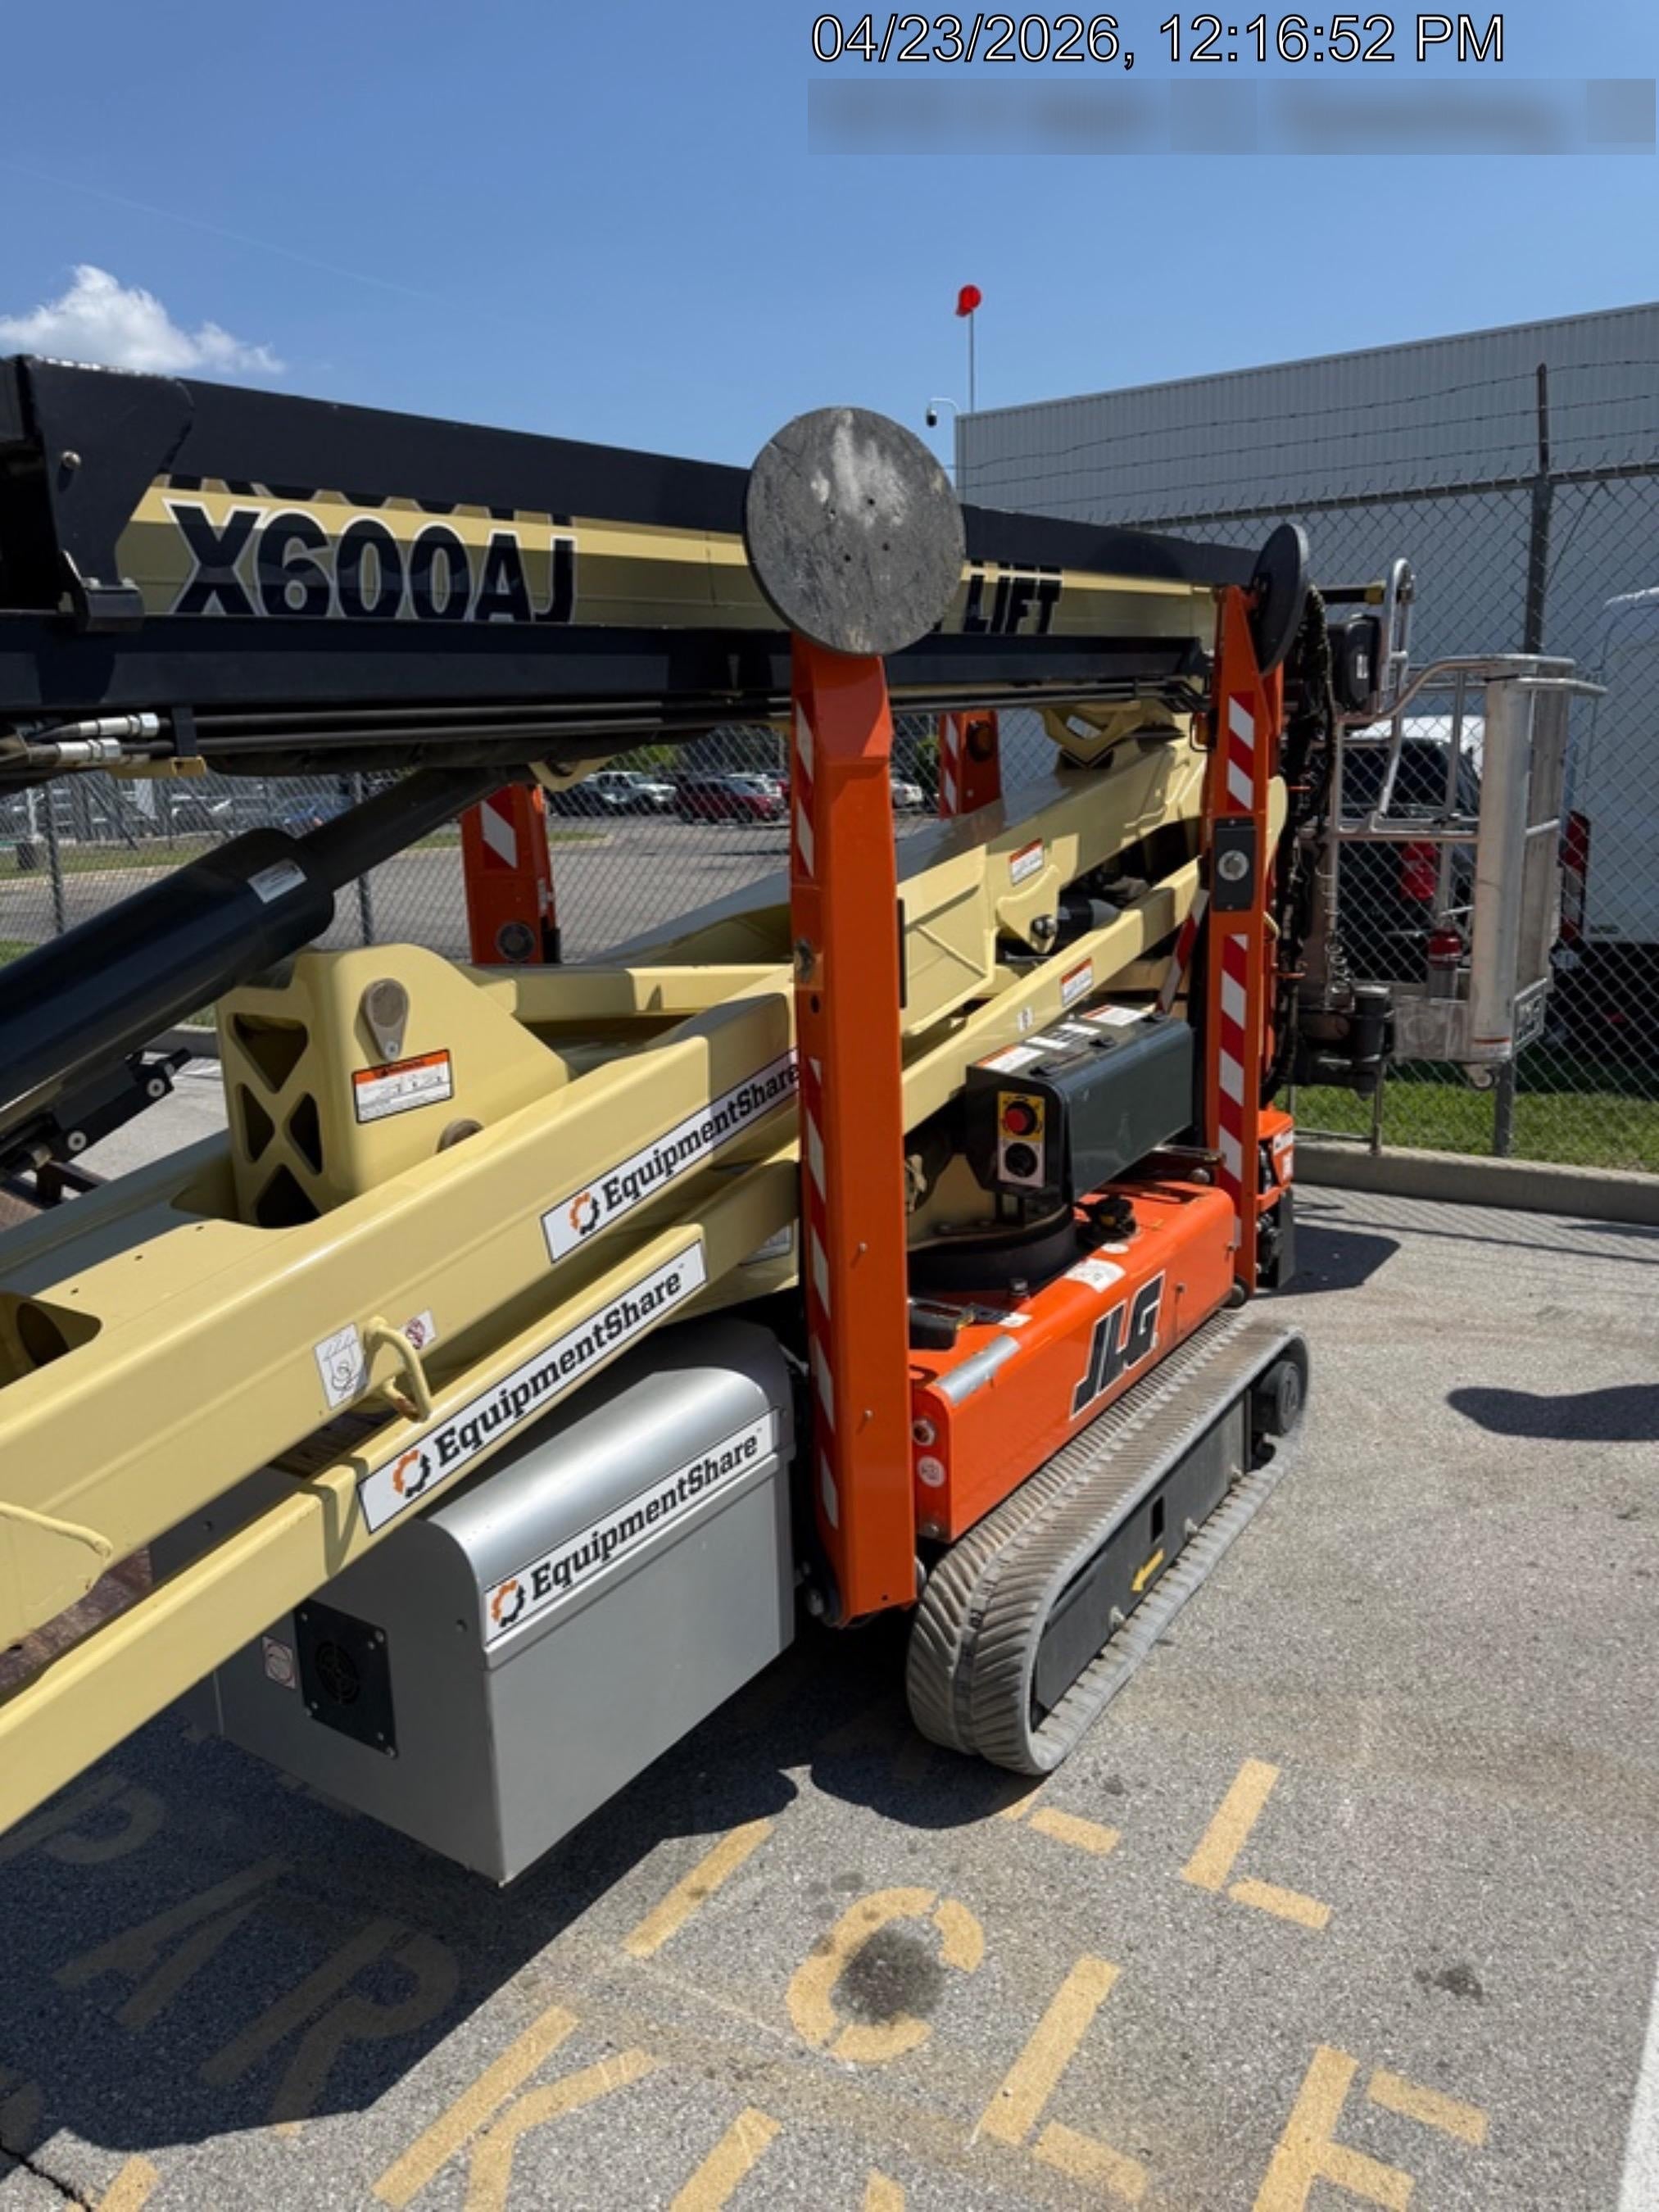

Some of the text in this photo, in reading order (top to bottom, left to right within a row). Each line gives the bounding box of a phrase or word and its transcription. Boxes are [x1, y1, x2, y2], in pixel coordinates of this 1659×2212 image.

[161, 496, 578, 622] X600AJ
[962, 570, 1063, 634] LIFT
[601, 1063, 800, 1212] EquipmentShare
[1069, 1269, 1167, 1422] JLG
